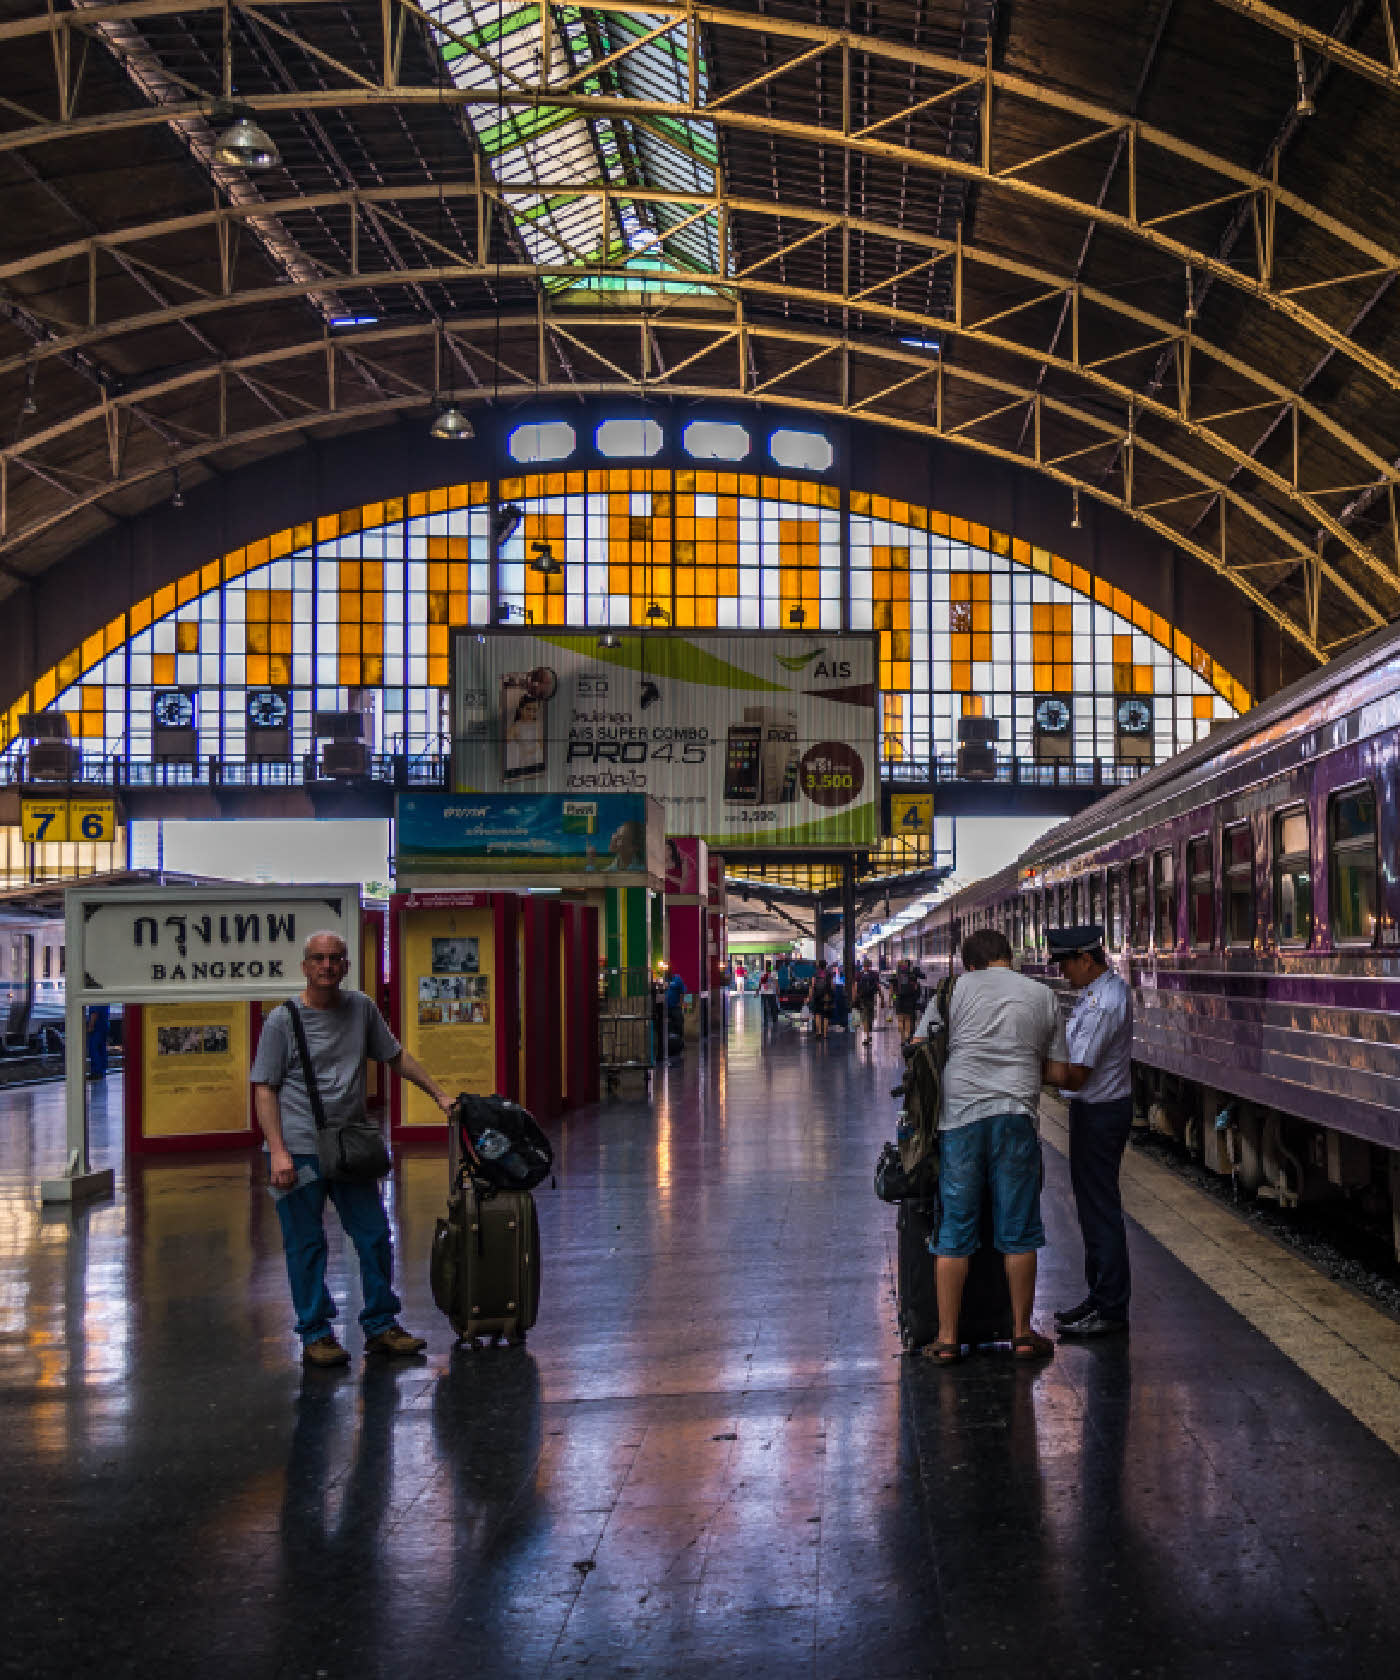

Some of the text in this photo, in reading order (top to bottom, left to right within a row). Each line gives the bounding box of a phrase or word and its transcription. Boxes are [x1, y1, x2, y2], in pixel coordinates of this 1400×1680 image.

[813, 661, 851, 678] AIS
[568, 726, 709, 740] AIS SUPER COMBO
[566, 741, 707, 764] PRO 4.5
[806, 774, 853, 790] 3,500
[31, 813, 56, 841] 7
[81, 813, 104, 839] 6
[902, 806, 923, 831] 4
[133, 912, 297, 957] กรุงเทพ
[151, 959, 284, 980] BANGKOK
